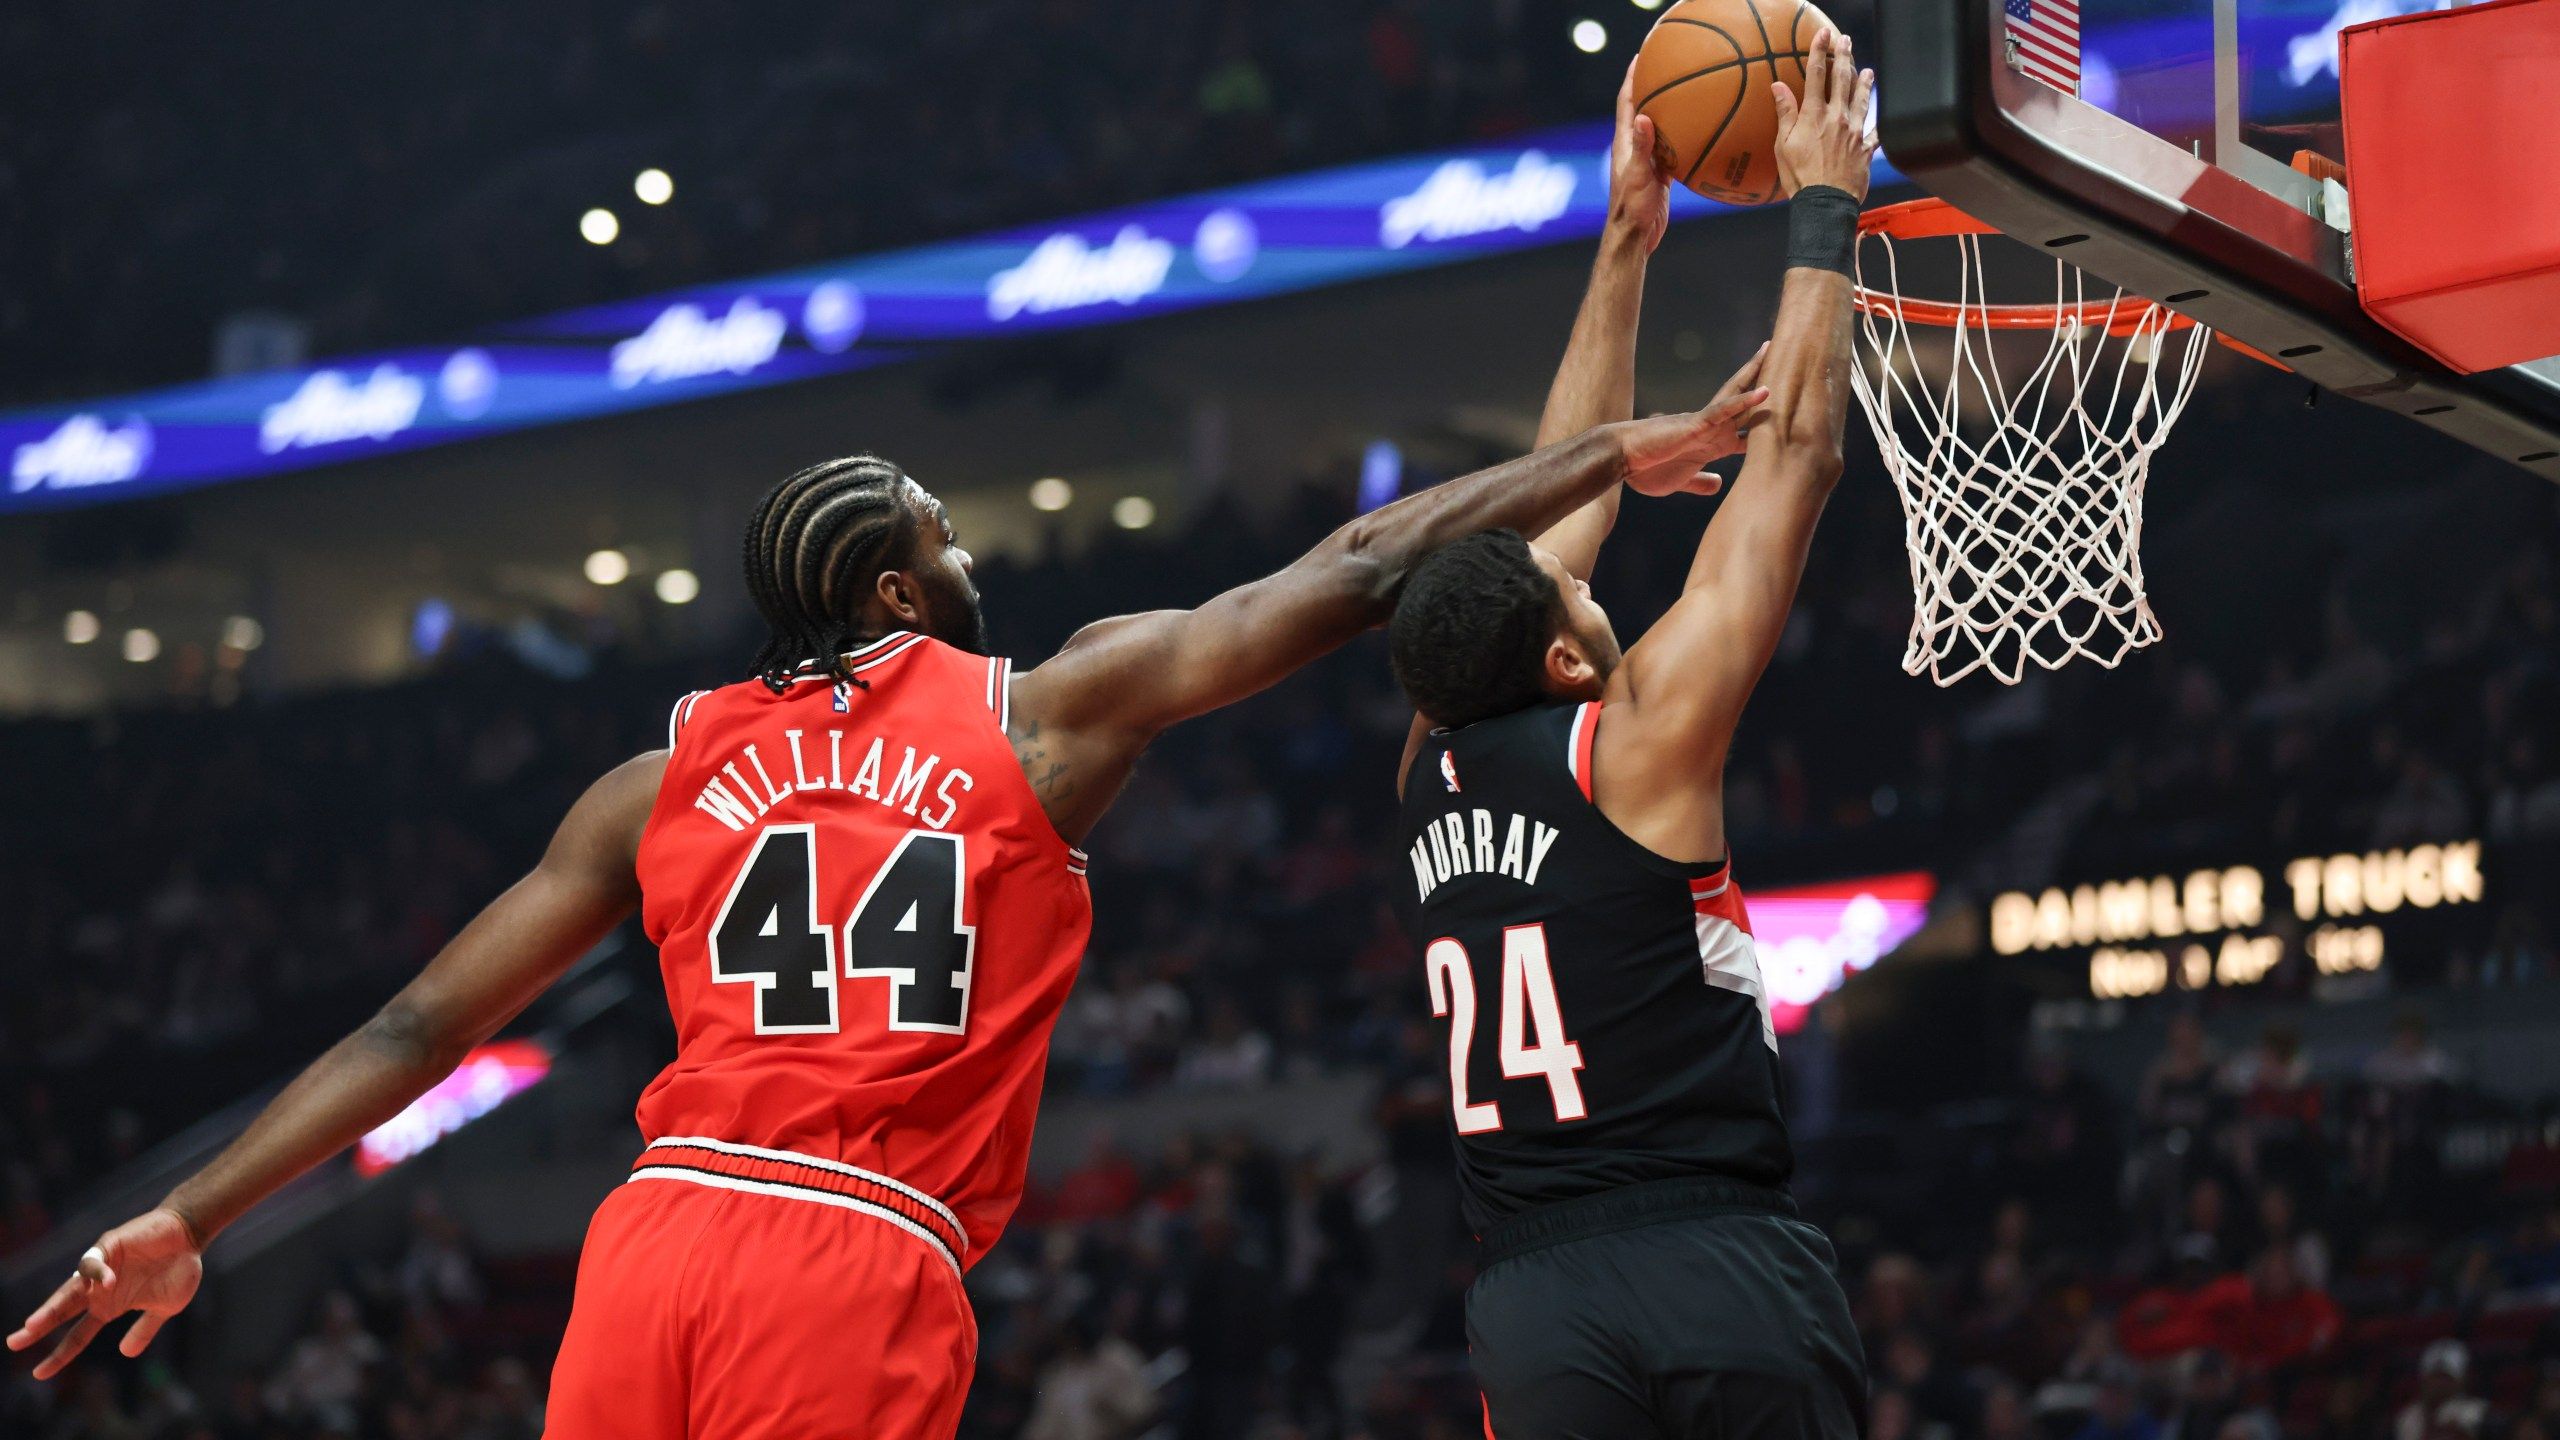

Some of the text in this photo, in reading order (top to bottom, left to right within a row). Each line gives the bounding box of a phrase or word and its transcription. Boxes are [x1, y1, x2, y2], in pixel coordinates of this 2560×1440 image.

[694, 730, 973, 831] WILLIAMS
[1410, 808, 1559, 904] MURRAY
[1991, 840, 2482, 954] DAIMLER TRUCK
[708, 822, 976, 1035] 44
[1425, 921, 1588, 1136] 24
